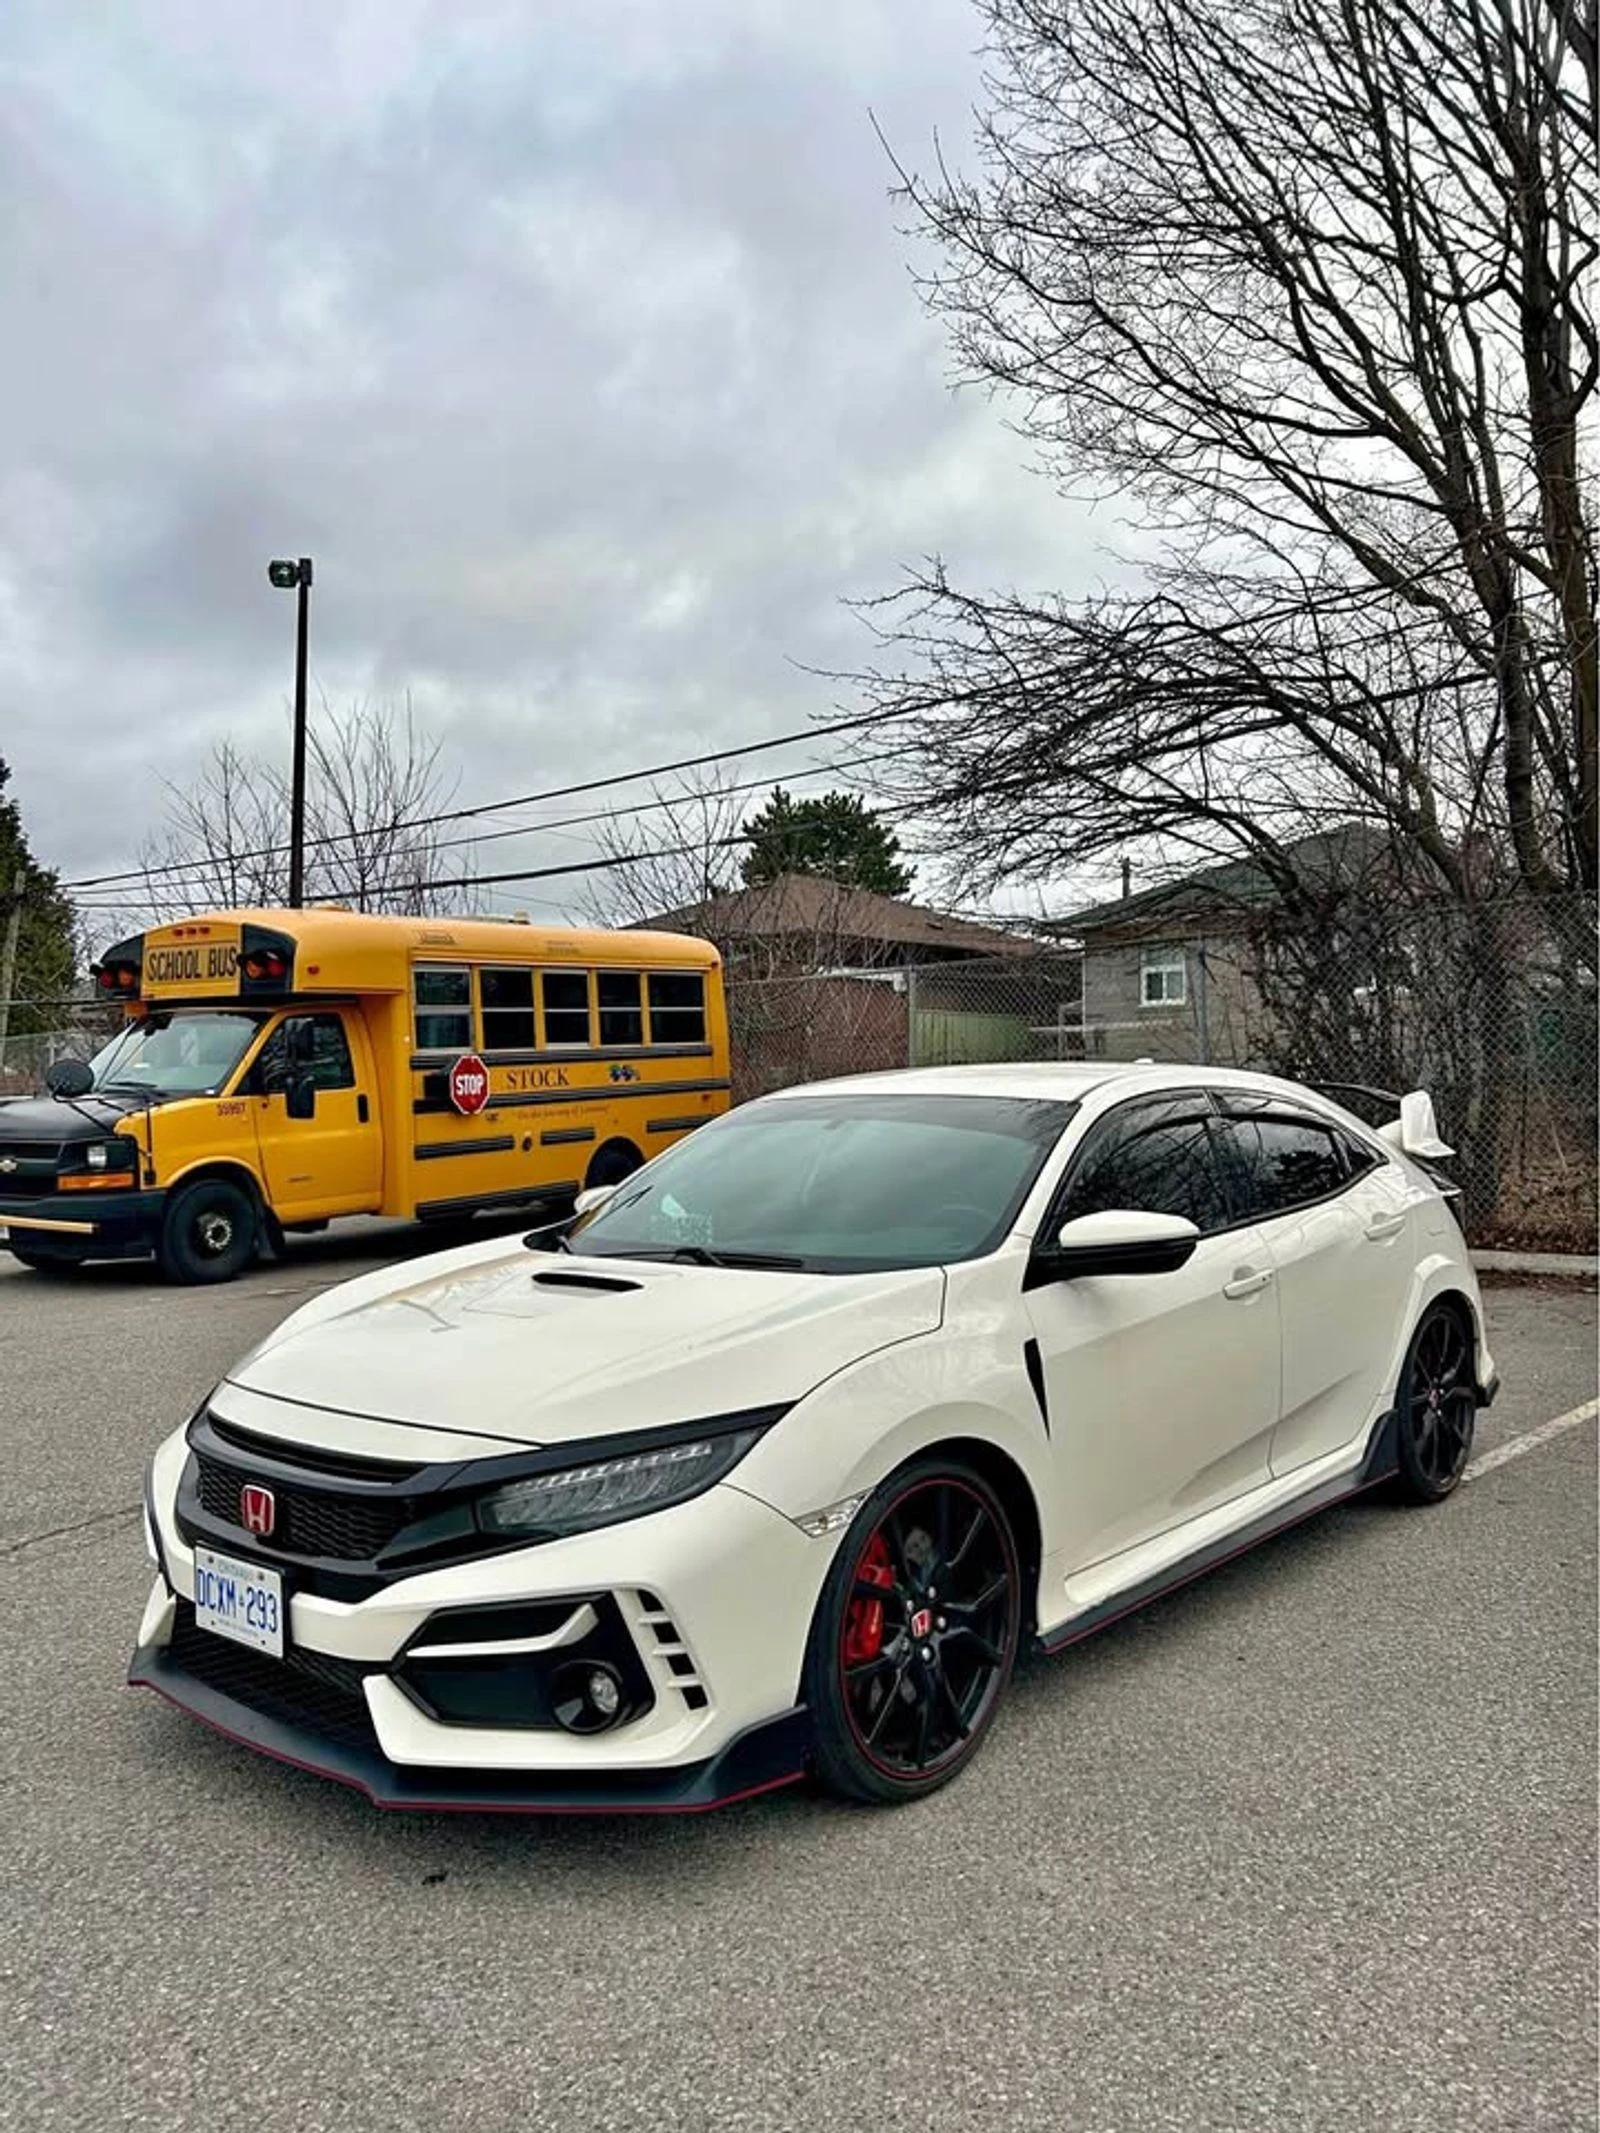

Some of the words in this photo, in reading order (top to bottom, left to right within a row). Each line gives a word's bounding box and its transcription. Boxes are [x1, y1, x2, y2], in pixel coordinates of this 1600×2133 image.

[148, 949, 202, 982] SCHOOL
[207, 945, 237, 977] BUS
[455, 1073, 484, 1096] STOP
[506, 1067, 570, 1090] STOCK
[197, 1568, 236, 1618] DCXM
[246, 1585, 277, 1634] 293
